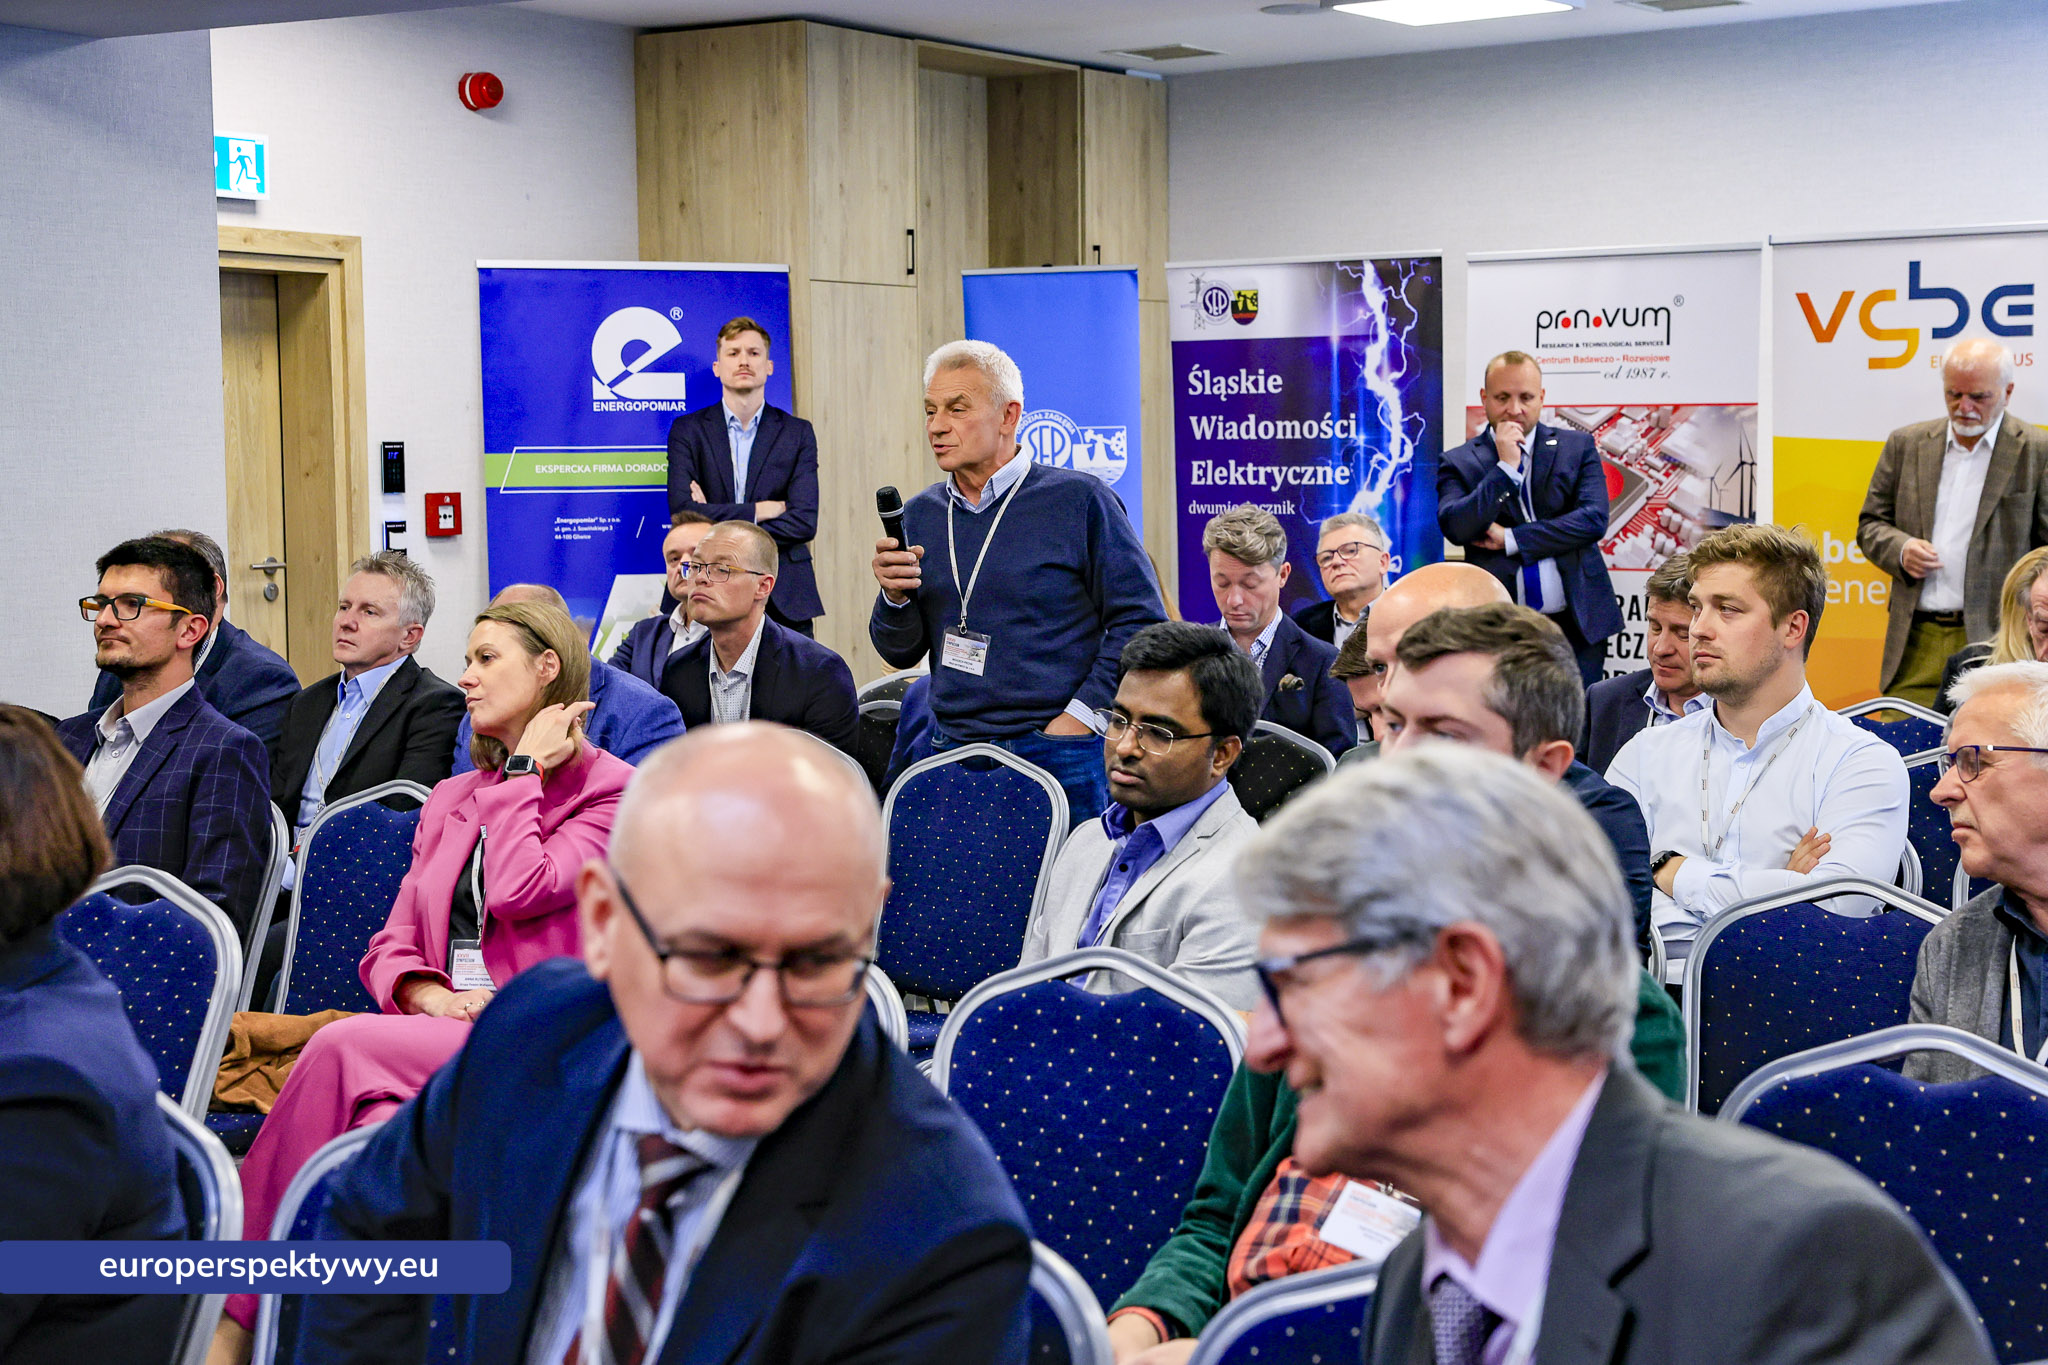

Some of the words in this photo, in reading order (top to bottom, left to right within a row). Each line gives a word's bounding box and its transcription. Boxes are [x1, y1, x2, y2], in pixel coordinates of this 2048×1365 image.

[1535, 355, 1571, 365] Centrum
[1573, 355, 1614, 364] Badawczo
[1622, 354, 1670, 364] Rozwojowe
[1603, 365, 1623, 379] od
[1626, 366, 1657, 379] 1987
[1187, 363, 1284, 402] Śląskie
[592, 401, 686, 412] ENERGOPOMIAR
[1189, 411, 1358, 441] Wiadomości
[535, 464, 591, 474] EKSPERCKA
[593, 464, 624, 473] FIRMA
[625, 463, 668, 473] DORADC
[1190, 459, 1350, 492] Elektryczne
